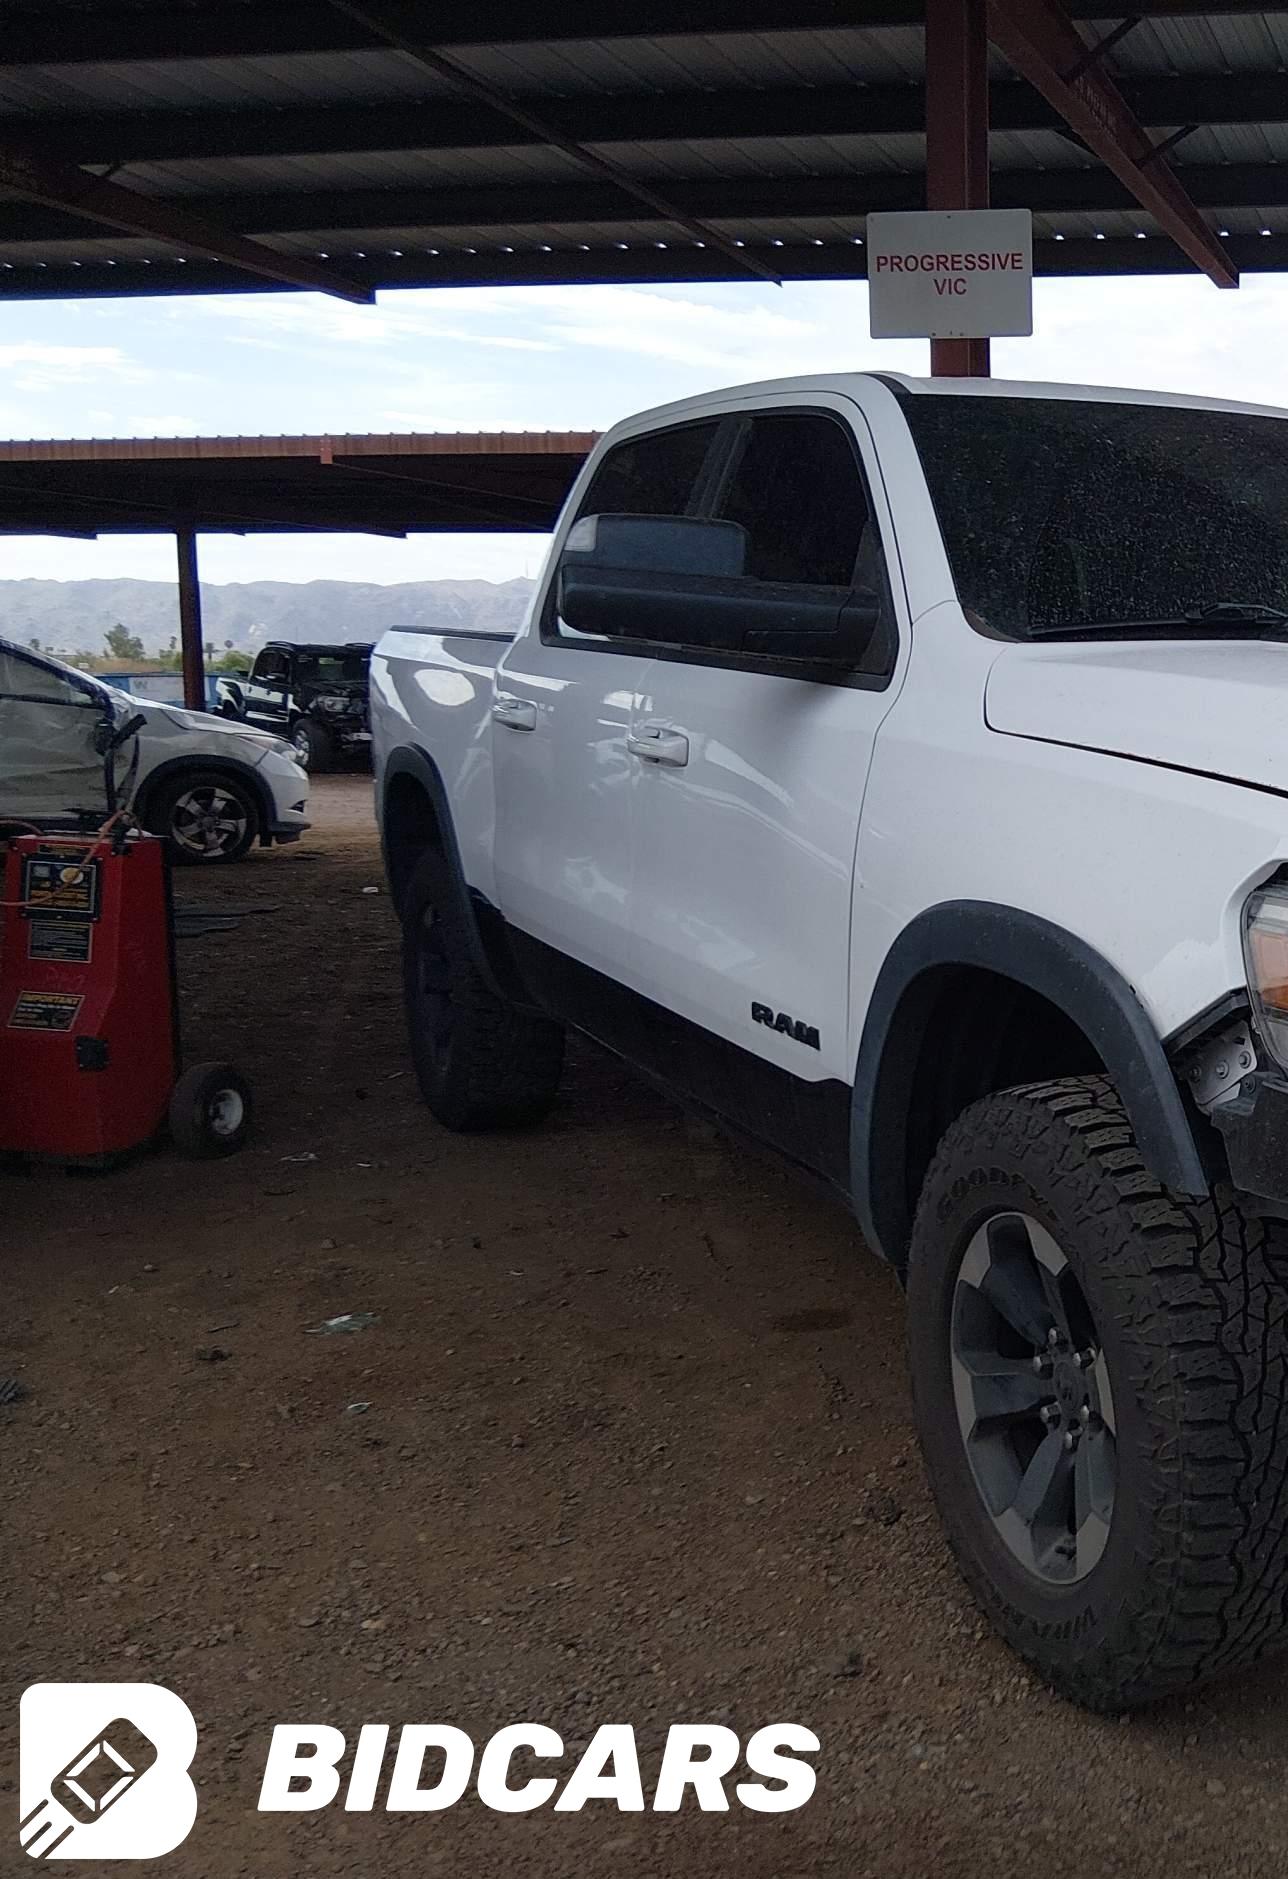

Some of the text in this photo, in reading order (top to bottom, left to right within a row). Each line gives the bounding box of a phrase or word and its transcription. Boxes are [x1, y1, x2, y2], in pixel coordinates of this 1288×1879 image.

[876, 252, 1024, 273] PROGRESSIVE
[933, 278, 968, 296] VIC
[751, 1001, 821, 1052] RAM
